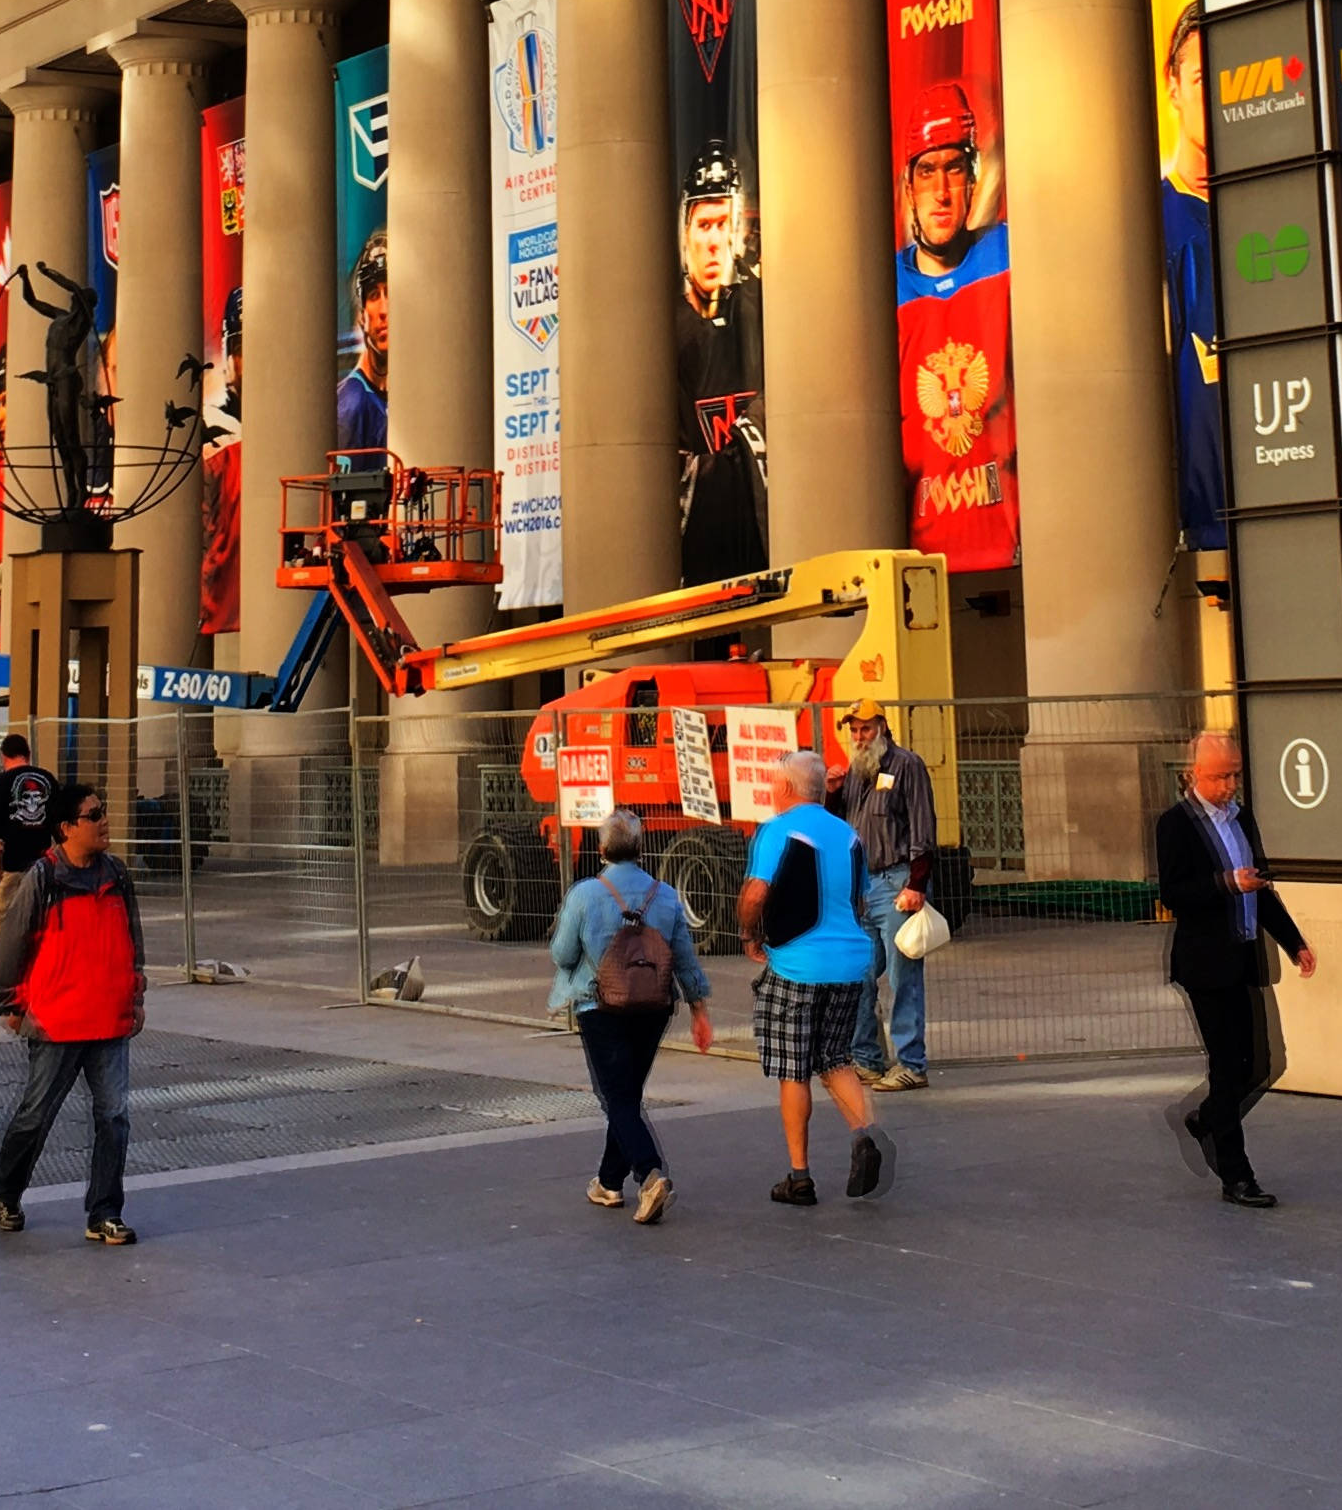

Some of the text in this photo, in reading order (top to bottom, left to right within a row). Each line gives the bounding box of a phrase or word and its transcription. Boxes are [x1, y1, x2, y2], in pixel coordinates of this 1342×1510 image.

[1220, 57, 1284, 105] VIA
[1223, 92, 1305, 123] VIA Rail Canada
[505, 174, 524, 189] AIR
[520, 180, 557, 202] CENTRE
[529, 264, 553, 288] FAN
[514, 283, 559, 308] VILLAG
[505, 368, 549, 397] SEPT
[1254, 377, 1312, 435] UP
[505, 410, 549, 439] SEPT
[507, 441, 559, 461] DISTILLE
[1255, 444, 1314, 466] Express
[515, 458, 560, 477] DISTRIC
[511, 495, 562, 514] #WCH201
[161, 671, 231, 702] Z-80/60
[739, 722, 753, 740] ALL
[562, 754, 609, 782] DANGER
[736, 766, 753, 783] SITE
